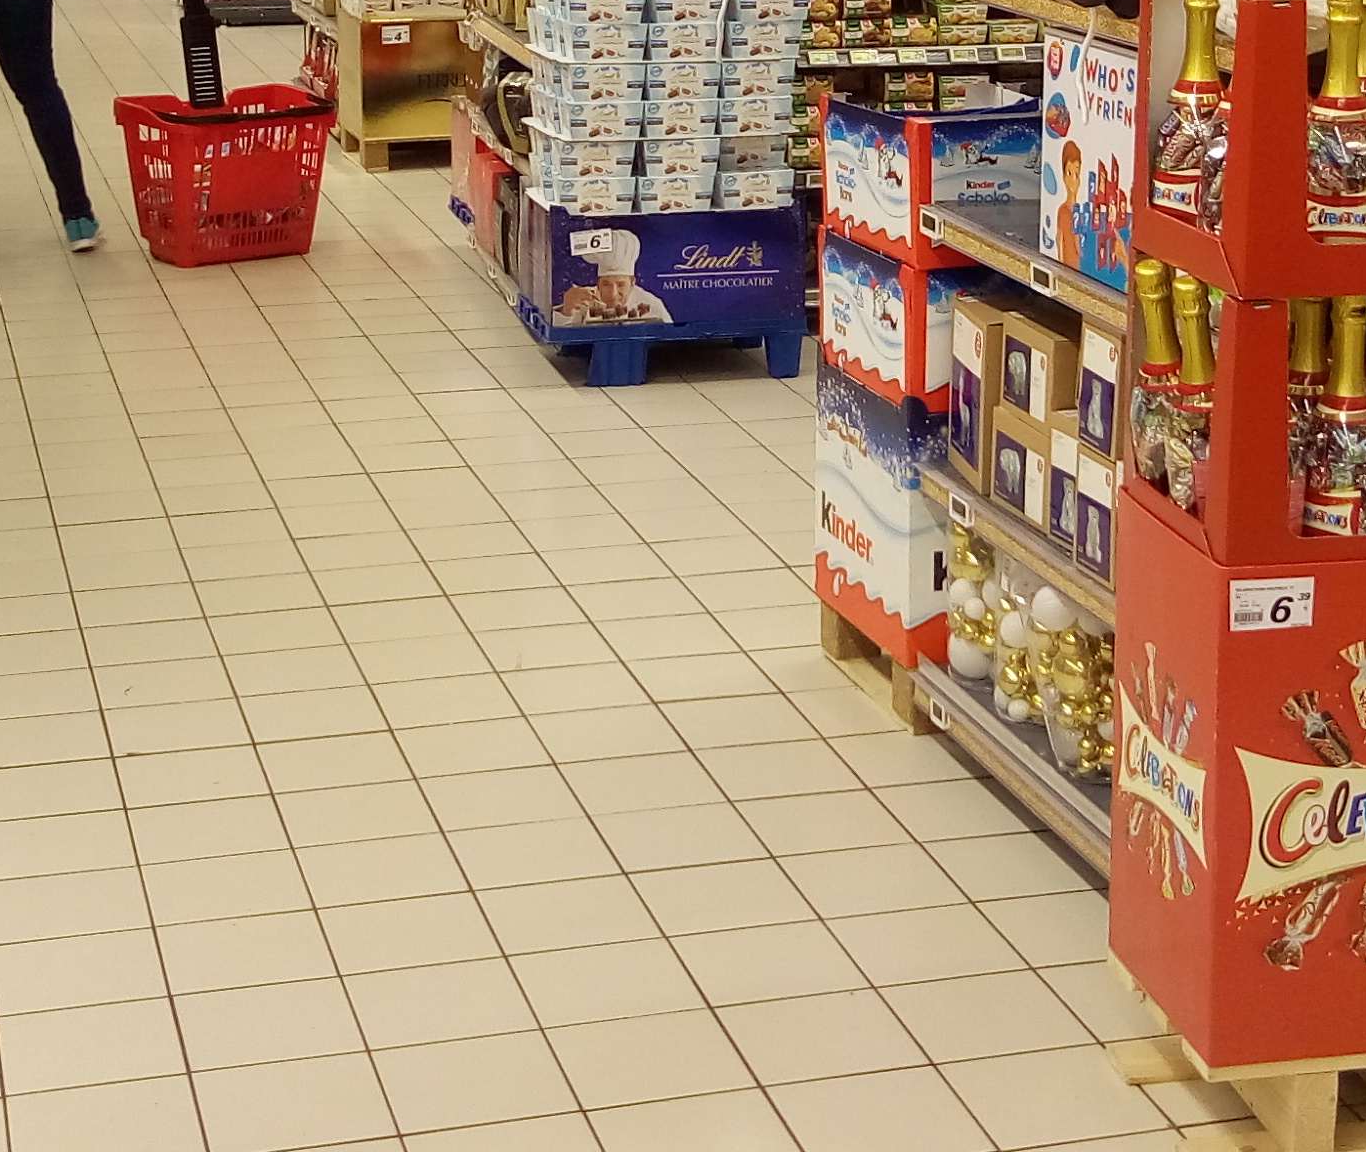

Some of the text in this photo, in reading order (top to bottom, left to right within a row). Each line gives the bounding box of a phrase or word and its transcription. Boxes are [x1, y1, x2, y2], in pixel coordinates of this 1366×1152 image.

[393, 31, 403, 42] 4
[1084, 57, 1135, 93] WHO'S
[590, 234, 602, 249] 6
[675, 244, 747, 269] Lindt
[702, 276, 774, 290] CHOCOLATIER
[821, 490, 873, 563] Kinder
[1269, 591, 1311, 624] 6 39
